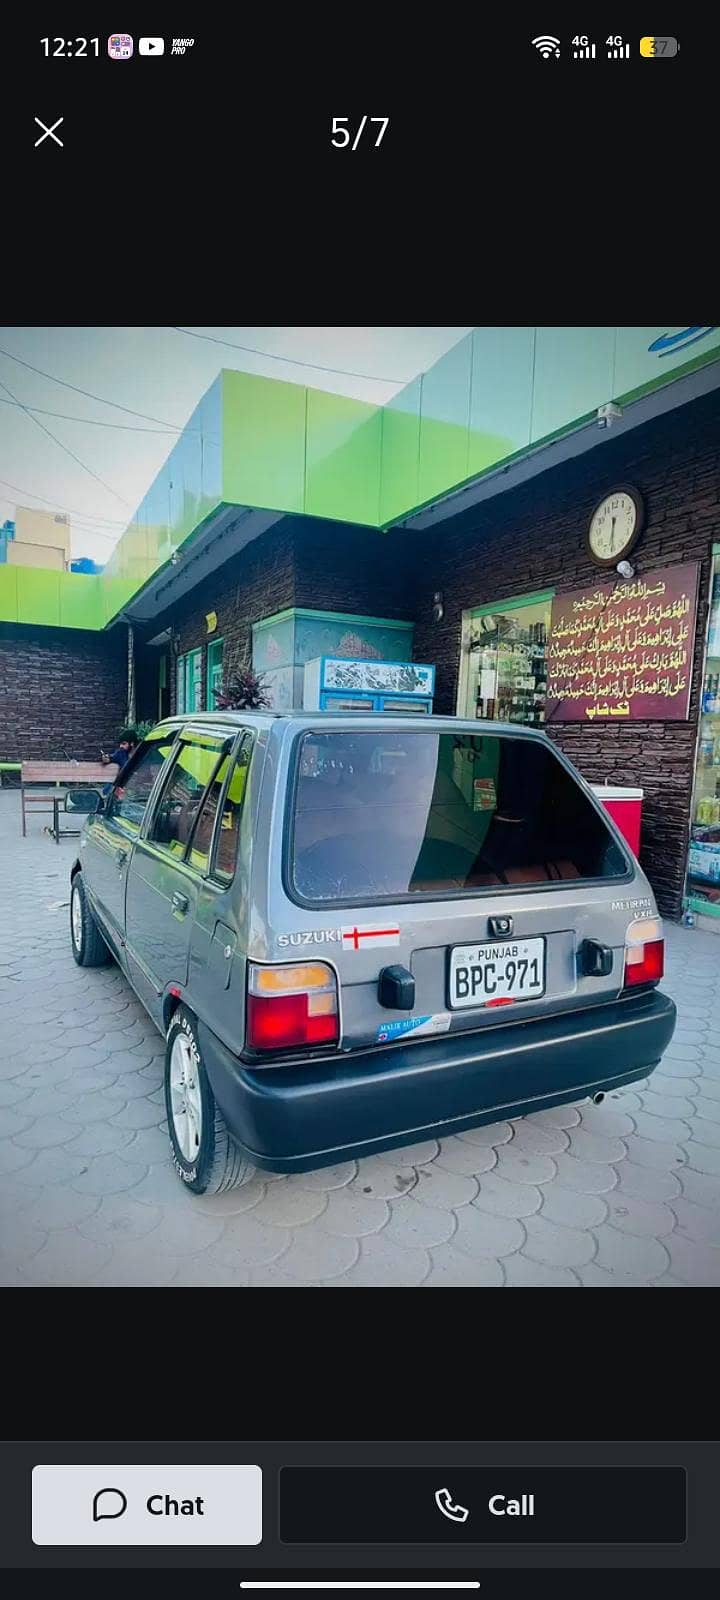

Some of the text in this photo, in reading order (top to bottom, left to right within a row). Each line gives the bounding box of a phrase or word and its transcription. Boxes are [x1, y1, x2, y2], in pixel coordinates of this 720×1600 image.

[277, 927, 341, 947] SUZUKI
[477, 944, 519, 962] PUNJAB
[454, 957, 541, 999] BPC-971
